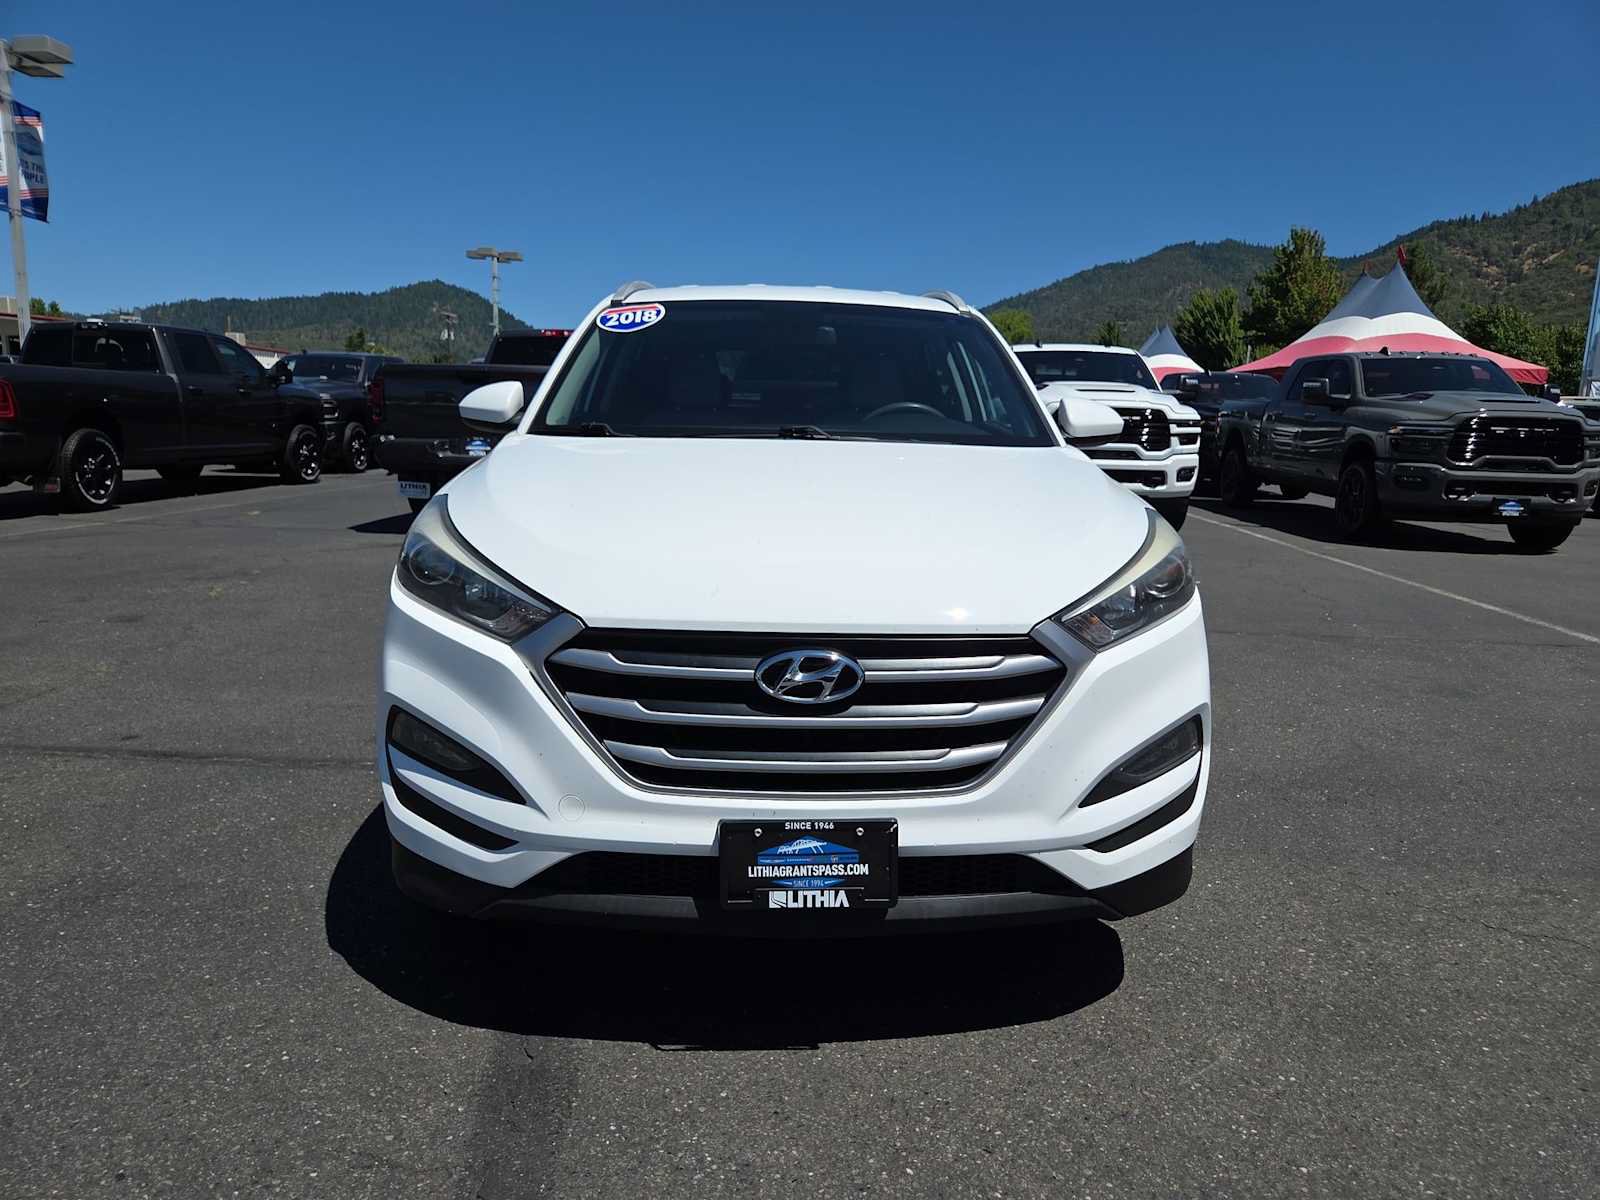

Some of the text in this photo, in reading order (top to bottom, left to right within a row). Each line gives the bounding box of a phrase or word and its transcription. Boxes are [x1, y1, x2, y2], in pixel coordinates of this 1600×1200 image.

[605, 310, 657, 327] 2018
[785, 822, 834, 830] SINCE 1946
[748, 864, 869, 878] LITHIAGRANTSPASS.COM
[787, 890, 850, 908] LITHIA
